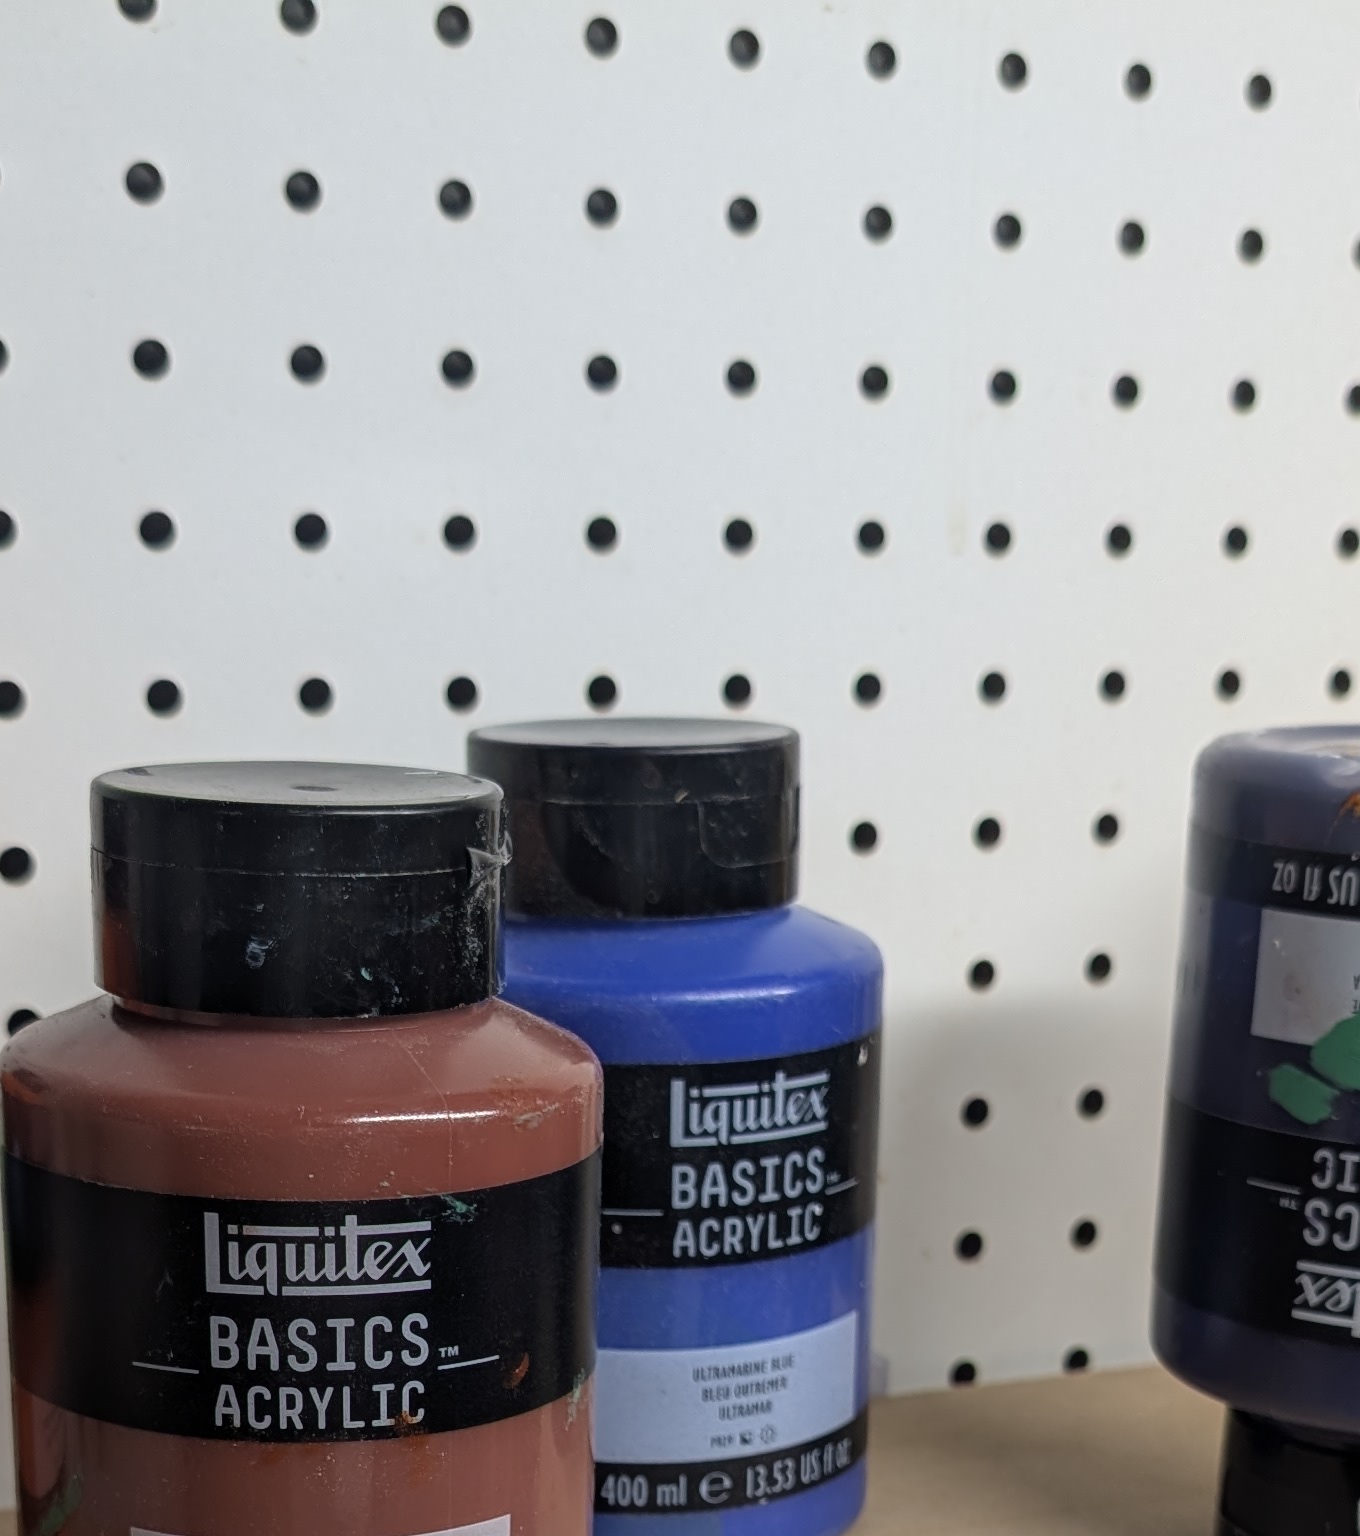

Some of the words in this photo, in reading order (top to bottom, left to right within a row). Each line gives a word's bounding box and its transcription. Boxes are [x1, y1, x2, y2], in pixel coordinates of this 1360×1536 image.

[1302, 865, 1322, 901] fl
[669, 1069, 831, 1148] Liquitex
[671, 1145, 826, 1210] BASICS
[203, 1211, 432, 1296] Liquitex
[672, 1201, 824, 1258] ACRYLIC
[209, 1312, 429, 1373] BASICS
[692, 1360, 769, 1382] ULTRAMARINE
[770, 1354, 795, 1372] BLUE
[214, 1380, 425, 1430] ACRYLIC
[701, 1386, 731, 1402] BLEU
[734, 1375, 788, 1398] OUTREMER
[718, 1399, 773, 1421] ULTRAMAR
[600, 1473, 649, 1507] 400
[656, 1473, 687, 1507] ml
[745, 1457, 797, 1499] 13.53
[800, 1447, 822, 1484] US
